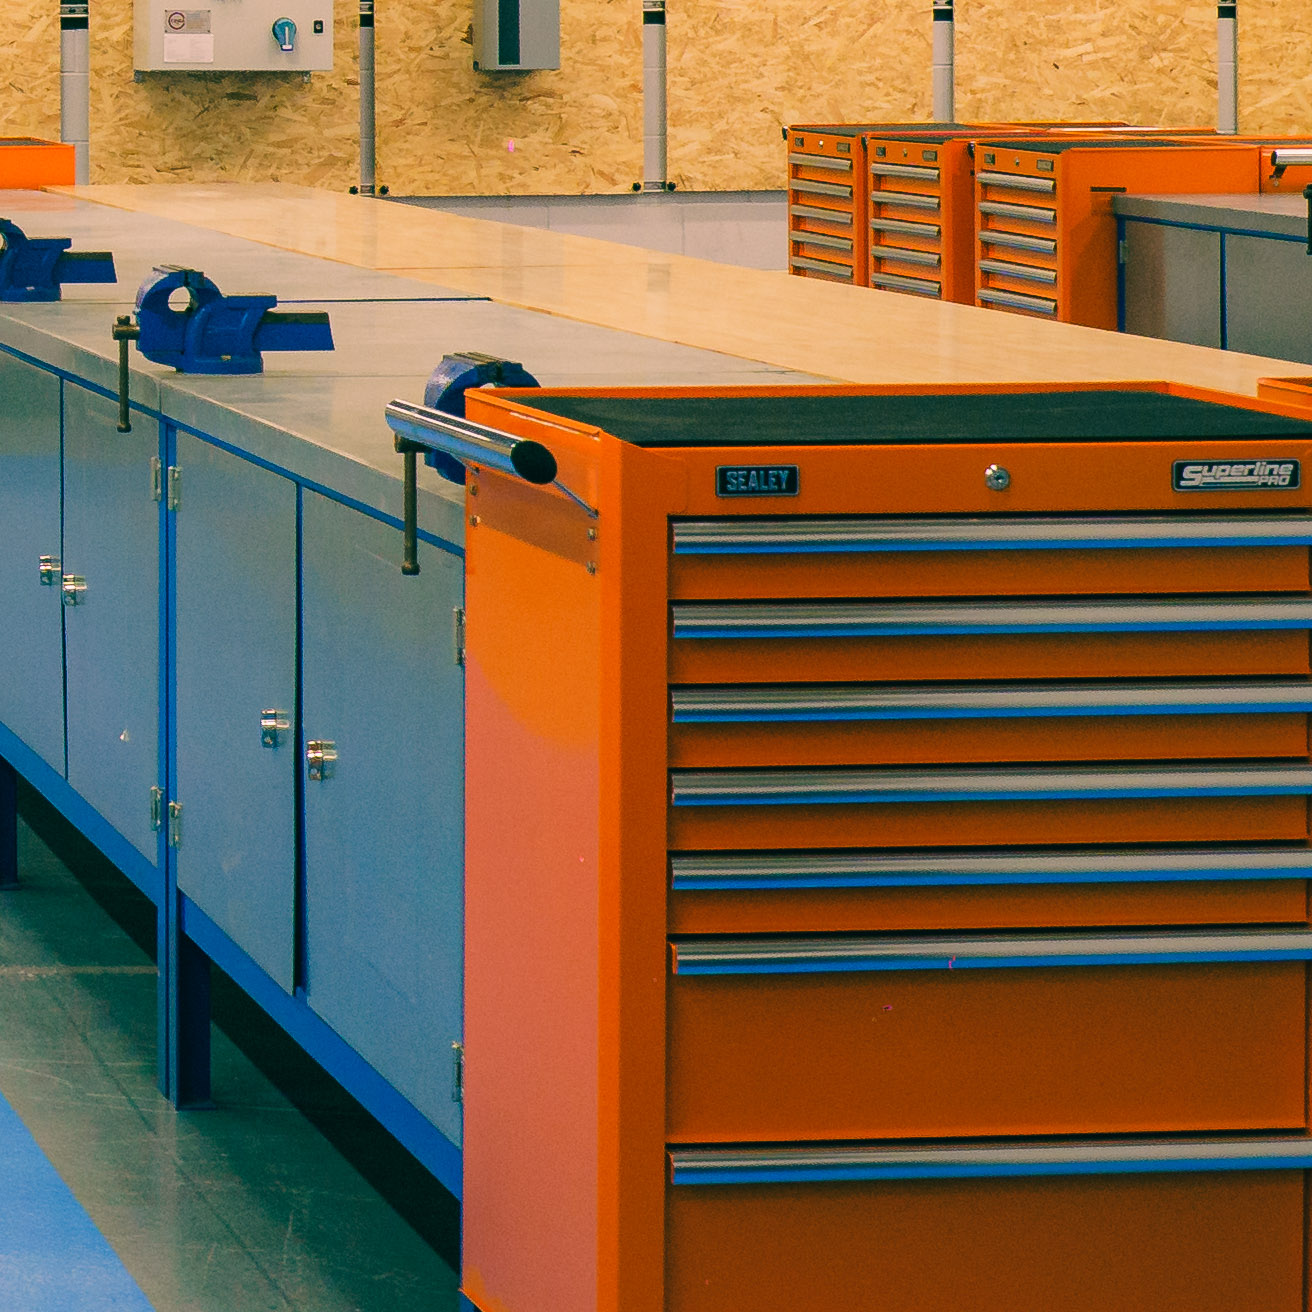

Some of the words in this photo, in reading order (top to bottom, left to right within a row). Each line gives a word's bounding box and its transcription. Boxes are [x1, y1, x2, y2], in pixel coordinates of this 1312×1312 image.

[726, 470, 789, 491] SEALEY
[1180, 462, 1294, 486] Superline
[1257, 475, 1291, 486] PRO
